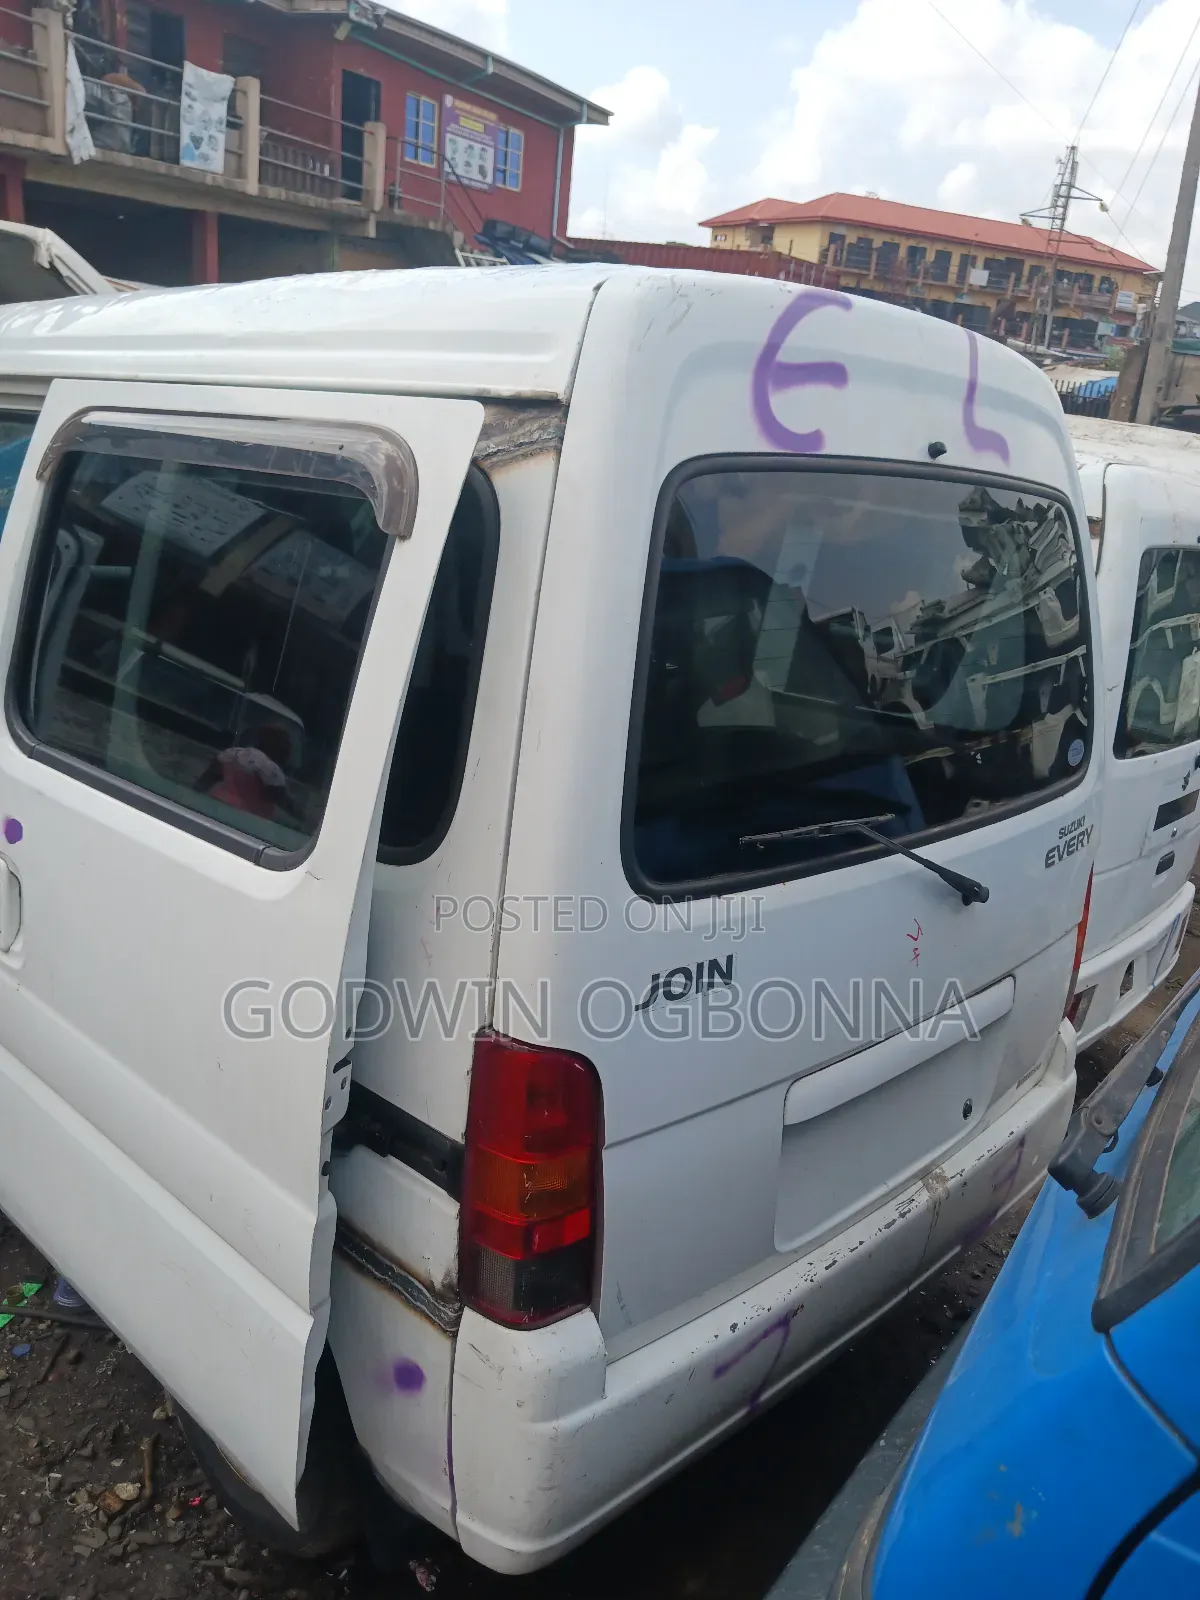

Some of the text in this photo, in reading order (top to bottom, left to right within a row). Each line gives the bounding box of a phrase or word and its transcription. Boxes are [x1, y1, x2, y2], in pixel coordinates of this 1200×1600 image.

[751, 290, 853, 455] E
[1045, 824, 1094, 868] EVERY
[1058, 815, 1086, 839] SUZUKI
[634, 953, 734, 1012] JOIN
